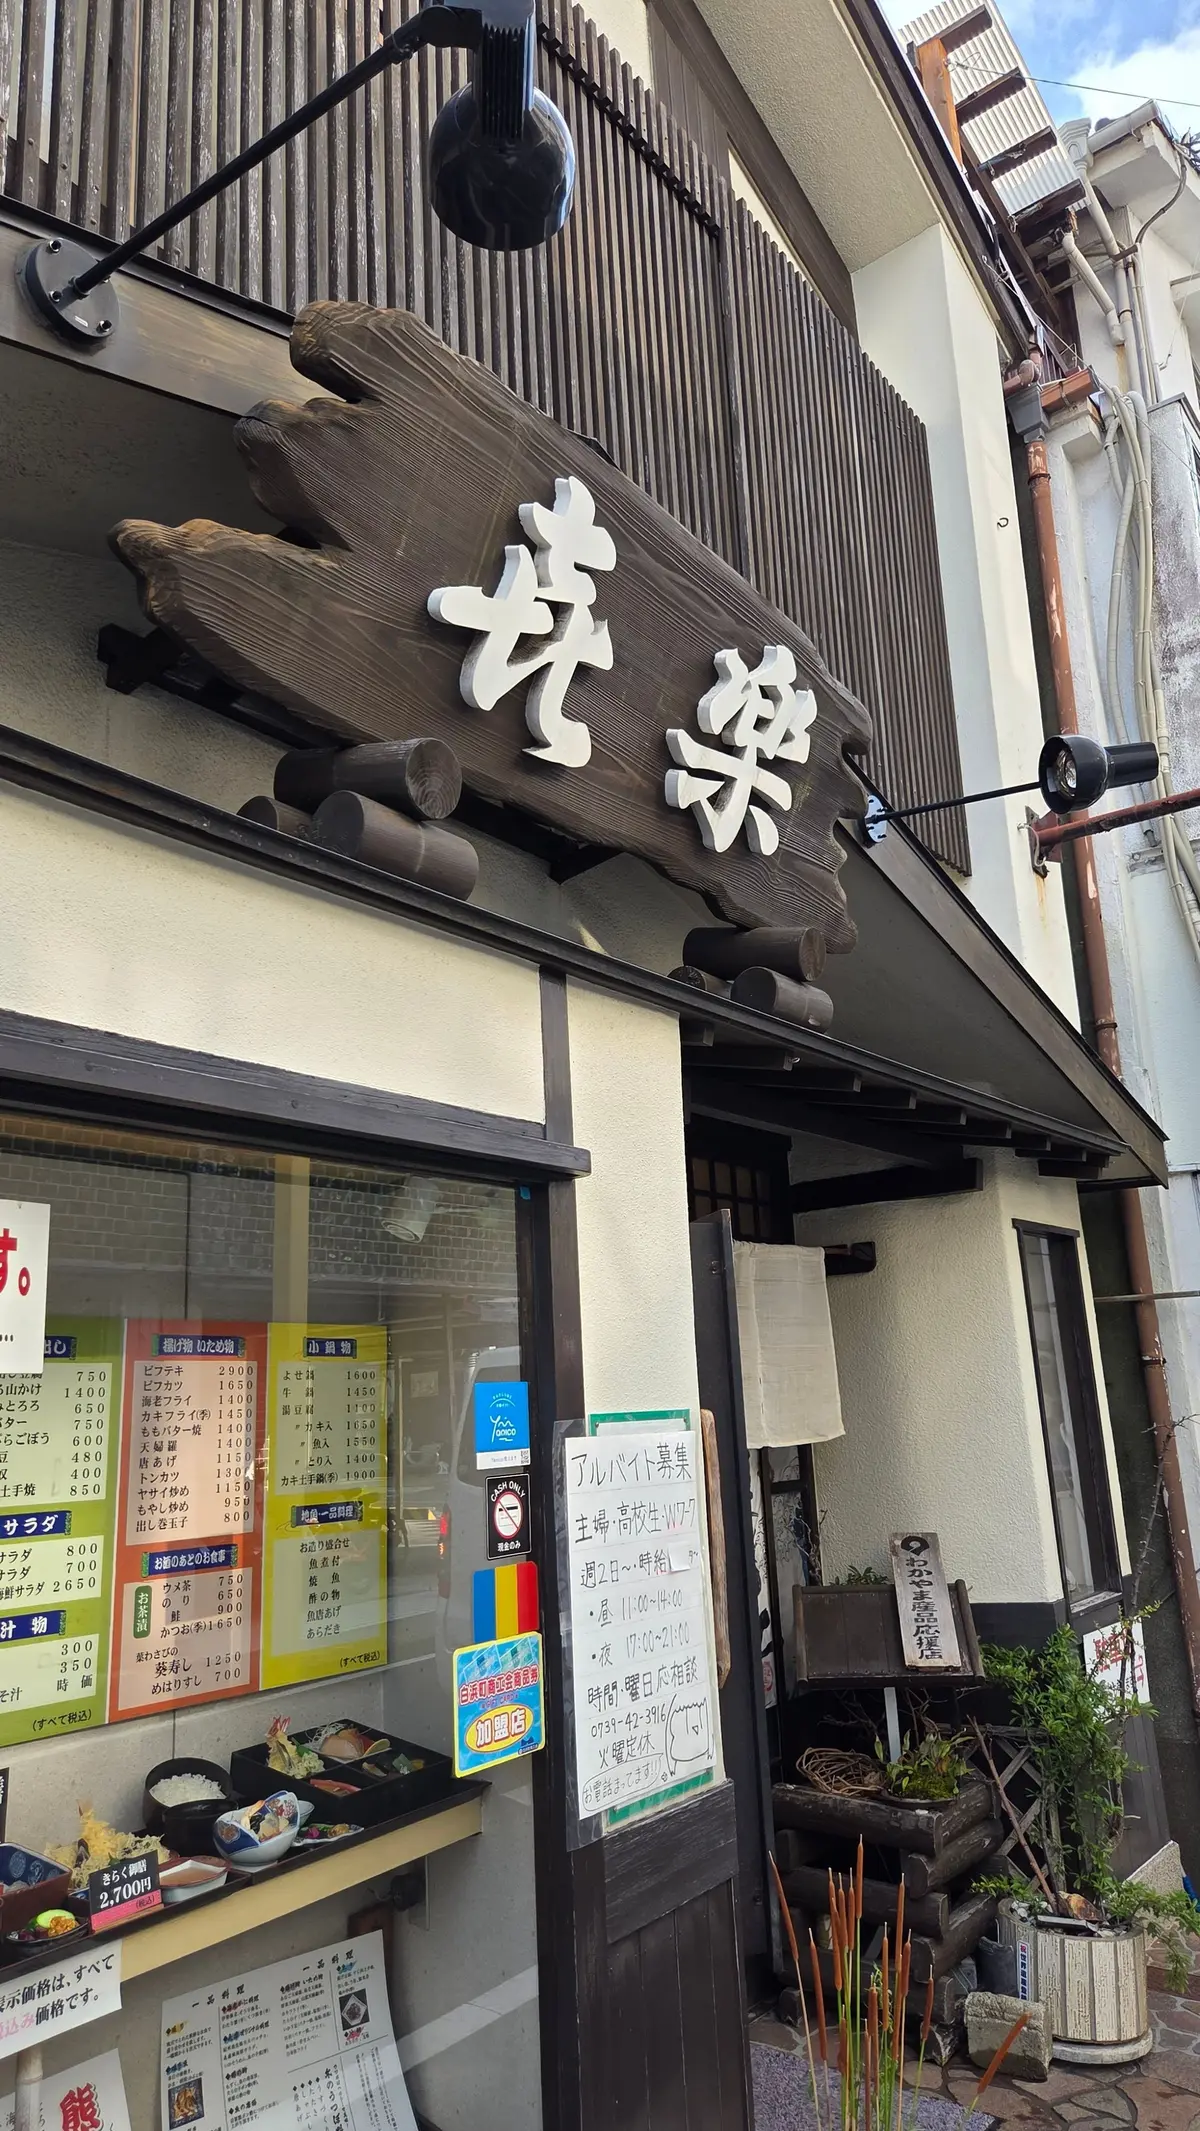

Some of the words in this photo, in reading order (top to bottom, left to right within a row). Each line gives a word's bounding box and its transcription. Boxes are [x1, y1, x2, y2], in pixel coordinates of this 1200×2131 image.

[163, 1338, 193, 1353] 揚げ物
[197, 1339, 234, 1354] いため物
[76, 1371, 107, 1382] 750
[144, 1365, 184, 1376] ビフテキ
[219, 1366, 253, 1376] 2900
[347, 1371, 376, 1379] 1600
[65, 1387, 106, 1398] 1400
[143, 1380, 183, 1392] ビフカツ
[219, 1380, 253, 1390] 1650
[347, 1387, 376, 1396] 1450
[75, 1403, 105, 1414] 650
[142, 1395, 192, 1407] 海老フライ
[219, 1395, 252, 1404] 1400
[347, 1404, 376, 1413] 1100
[218, 1409, 252, 1419] 1450
[74, 1420, 104, 1430] 750
[141, 1424, 202, 1437] ももバター焼
[218, 1423, 252, 1433] 1400
[347, 1421, 376, 1430] 1650
[0, 1432, 49, 1446] らごぼう
[73, 1435, 103, 1446] 600
[218, 1438, 251, 1448] 1400
[346, 1438, 376, 1447] 1550
[72, 1451, 102, 1463] 480
[139, 1455, 177, 1469] 唐あげ
[217, 1453, 251, 1463] 1150
[346, 1454, 376, 1463] 1400
[572, 1442, 692, 1487] アルバイト募集
[70, 1468, 102, 1479] 400
[139, 1472, 180, 1484] トンカツ
[217, 1467, 250, 1478] 130
[346, 1471, 376, 1480] 1900
[0, 1483, 36, 1498] 土手焼
[70, 1484, 100, 1496] 850
[138, 1486, 189, 1500] ヤサイ炒め
[216, 1481, 250, 1493] 1150
[491, 1481, 508, 1502] CASH
[509, 1480, 526, 1498] ONLY
[137, 1502, 189, 1516] もやし炒め
[225, 1497, 250, 1508] 950
[4, 1515, 58, 1536] サラダ
[136, 1517, 188, 1532] 出し巻玉子
[224, 1512, 249, 1522] 800
[67, 1544, 98, 1556] 800
[300, 1538, 350, 1553] お造り盛合せ
[497, 1540, 521, 1552] 現金のみ
[67, 1560, 97, 1573] 700
[155, 1549, 226, 1570] お酒のあとのお食事
[309, 1556, 341, 1569] 魚煮付
[53, 1577, 96, 1593] 2650
[163, 1580, 191, 1594] ウメ茶
[218, 1574, 243, 1585] 750
[162, 1595, 190, 1608] のり
[218, 1588, 243, 1600] 650
[309, 1589, 340, 1604] 酢の物
[136, 1592, 149, 1632] お茶漬
[217, 1602, 243, 1614] 900
[905, 1556, 944, 1660] わかやま産品応援店
[160, 1621, 207, 1639] かつお(季)
[209, 1616, 242, 1631] 1650
[307, 1623, 340, 1639] あらだき
[61, 1640, 93, 1656] 300
[136, 1647, 178, 1663] 葉わさびの
[60, 1659, 92, 1673] 350
[205, 1651, 241, 1667] 1250
[152, 1675, 202, 1695] めはりすし
[215, 1668, 241, 1682] 700
[476, 1708, 526, 1748] 加盟店
[591, 1703, 667, 1738] 0739-42-3916
[598, 1731, 655, 1769] 火曜定休
[102, 1859, 147, 1886] きらく御膳
[100, 1877, 151, 1909] 2,700円
